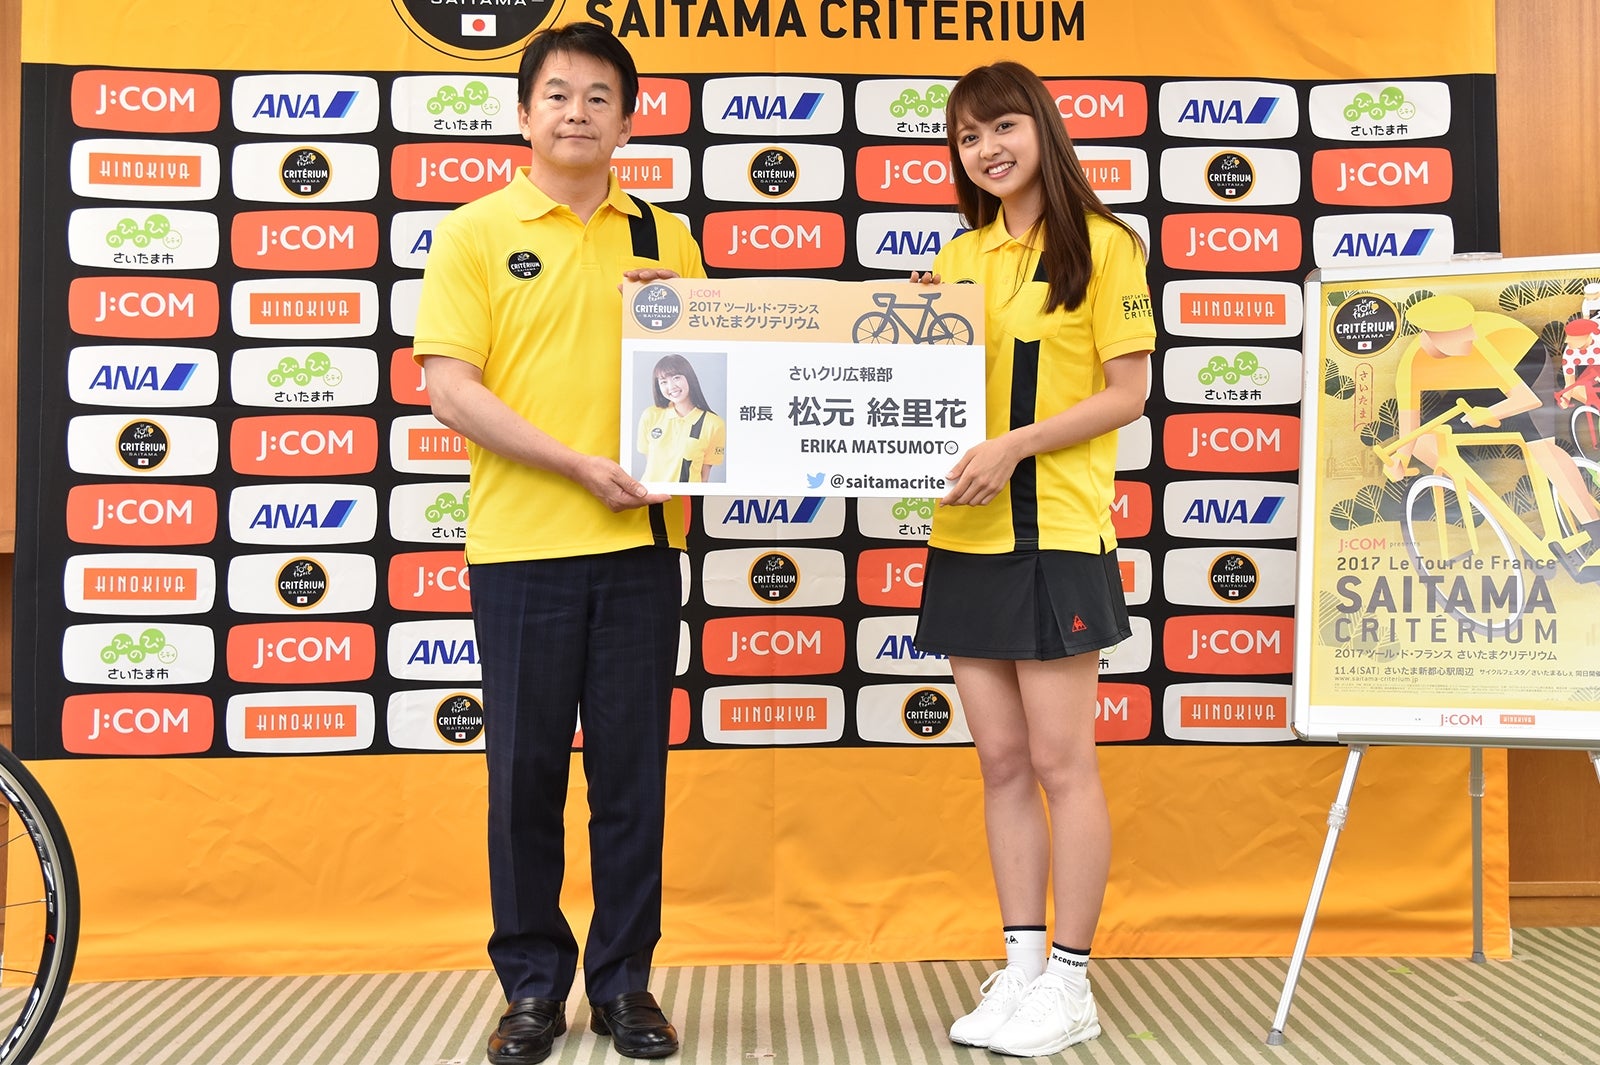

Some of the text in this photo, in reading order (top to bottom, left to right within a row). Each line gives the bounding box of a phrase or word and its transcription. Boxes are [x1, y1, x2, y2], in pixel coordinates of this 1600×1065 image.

[585, 0, 1085, 42] SAITAMA CRITERIUM
[96, 85, 194, 114] J:COM
[253, 94, 320, 118] ANA
[722, 96, 787, 119] ANA
[1061, 95, 1123, 118] COM
[1178, 100, 1243, 123] ANA
[434, 119, 491, 130] さいたま市
[1351, 124, 1407, 136] さいたま市
[100, 161, 189, 178] HINOKIYA
[284, 169, 328, 179] CRITÉRIUM
[416, 158, 515, 189] J:COM
[753, 169, 794, 179] CRITÉRIUM
[1209, 172, 1251, 182] CRITÉRIUM
[1337, 161, 1428, 191] J:COM
[257, 225, 353, 255] J:COM
[728, 225, 820, 254] J:COM
[876, 231, 941, 255] ANA
[1186, 228, 1277, 256] J:COM
[1333, 233, 1397, 256] ANA
[114, 253, 173, 264] さいたま市
[689, 289, 720, 299] J:COM
[96, 292, 193, 321] J:COM
[262, 300, 349, 316] HINOKIYA
[635, 304, 678, 313] CRITÉRIUM
[689, 302, 819, 314] 2017 ツール・ド・フランス
[1123, 299, 1149, 311] SAIT
[1192, 301, 1274, 316] HINOKIYA
[689, 315, 820, 330] さいたまクリテリウム
[1336, 321, 1395, 334] CRITÉRIUM
[89, 366, 158, 390] ANA
[789, 366, 893, 382] さいクリ広報部
[275, 391, 333, 402] さいたま市
[1205, 390, 1261, 400] さいたま市
[740, 396, 967, 428] 部長 松元 絵里花
[121, 442, 165, 451] CRITÉRIUM
[256, 430, 352, 461] J:COM
[420, 437, 460, 452] HINO
[800, 439, 847, 453] ERIKA
[1188, 428, 1279, 457] J:COM
[93, 499, 192, 529] J:COM
[250, 504, 317, 528] ANA
[723, 499, 788, 524] ANA
[1183, 500, 1247, 523] ANA
[432, 527, 466, 538] さいた
[899, 524, 932, 535] さいた
[1338, 538, 1385, 553] J:COM
[1337, 556, 1555, 570] 2017 Le Tour de France
[95, 576, 185, 592] HINOKIYA
[280, 580, 324, 590] CRITÉRIUM
[414, 567, 470, 597] J:C
[753, 574, 795, 584] CRITÉRIUM
[882, 563, 923, 592] J:C
[1213, 574, 1254, 583] CRITÉRIUM
[1336, 576, 1555, 614] SAITAMA
[1335, 615, 1557, 644] CRITÉRIUM
[253, 637, 350, 668] J:COM
[407, 640, 475, 664] ANA
[728, 631, 820, 661] J:COM
[1188, 630, 1280, 659] J:COM
[1335, 649, 1557, 660] 2017 ツール・ド・フランス さいたまクリテリウム
[108, 668, 168, 679] さいたま市
[1384, 667, 1474, 676] さいたま新都心駅周辺
[732, 706, 815, 722] HINOKIYA
[906, 710, 948, 719] CRITÉRIUM
[1192, 704, 1275, 720] HINOKIYA
[1440, 714, 1482, 726] J:COM
[88, 709, 188, 739] J:COM
[257, 713, 344, 730] HINOKIYA
[439, 716, 482, 725] CRITÉRIUM
[1058, 957, 1071, 966] coq
